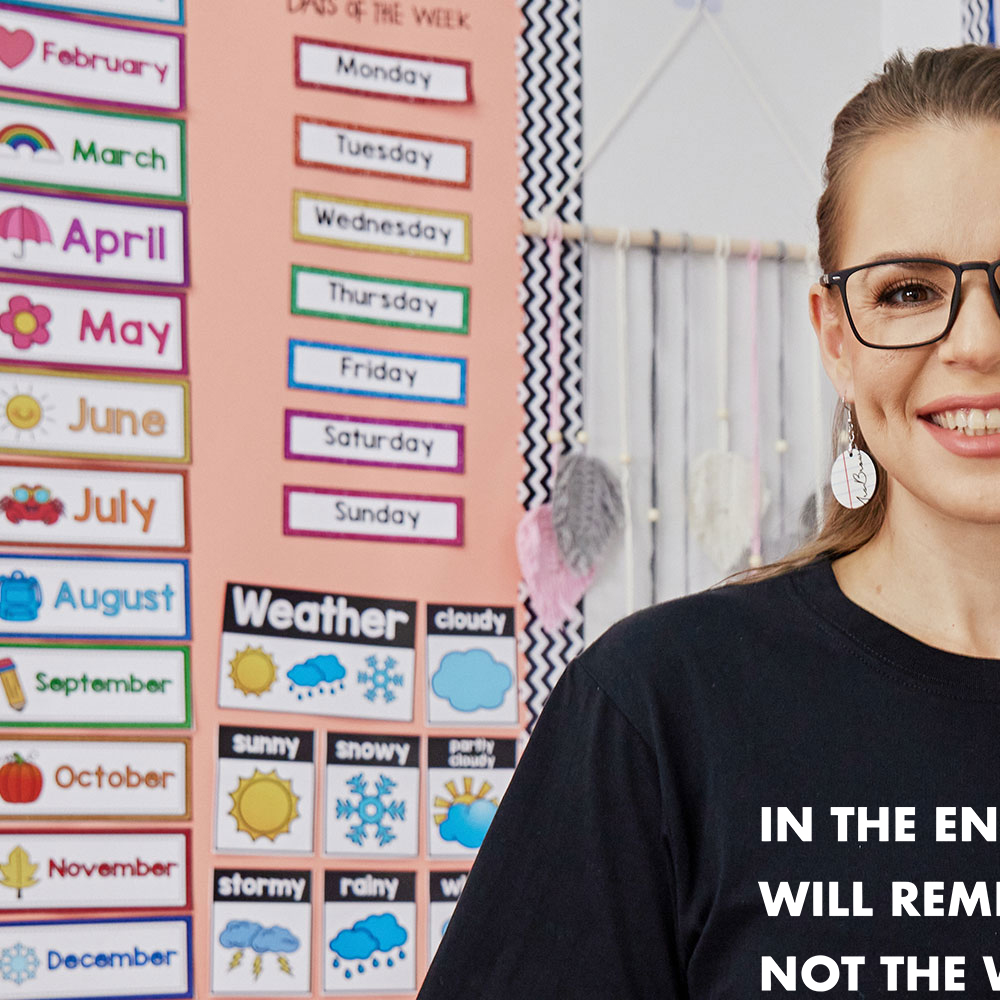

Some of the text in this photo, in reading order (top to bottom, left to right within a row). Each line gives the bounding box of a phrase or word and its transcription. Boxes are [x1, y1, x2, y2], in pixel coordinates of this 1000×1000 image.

[373, 1, 402, 25] THE
[412, 4, 471, 30] WEEK
[42, 41, 168, 84] February
[336, 56, 432, 91] Monday
[73, 138, 166, 170] March
[337, 135, 433, 170] Tuesday
[62, 218, 167, 263] April
[315, 206, 452, 245] Wednesday
[329, 282, 438, 317] Thursday
[79, 308, 170, 354] May
[340, 357, 418, 388] Friday
[69, 397, 166, 436] June
[325, 425, 435, 458] Saturday
[74, 488, 156, 534] July
[334, 501, 421, 530] Sunday
[54, 581, 175, 617] August
[232, 586, 409, 641] Weather
[434, 608, 507, 637] cloudy
[36, 672, 173, 697] September
[231, 733, 301, 762] sunny
[334, 739, 411, 767] snowy
[448, 752, 496, 769] cloudy
[55, 765, 175, 790] October
[762, 807, 812, 841] IN
[831, 807, 915, 841] THE
[48, 858, 179, 879] November
[217, 873, 306, 901] stormy
[339, 873, 399, 901] rainy
[758, 882, 873, 916] WILL
[47, 948, 178, 971] December
[762, 955, 865, 992] NOT
[880, 956, 965, 991] THE
